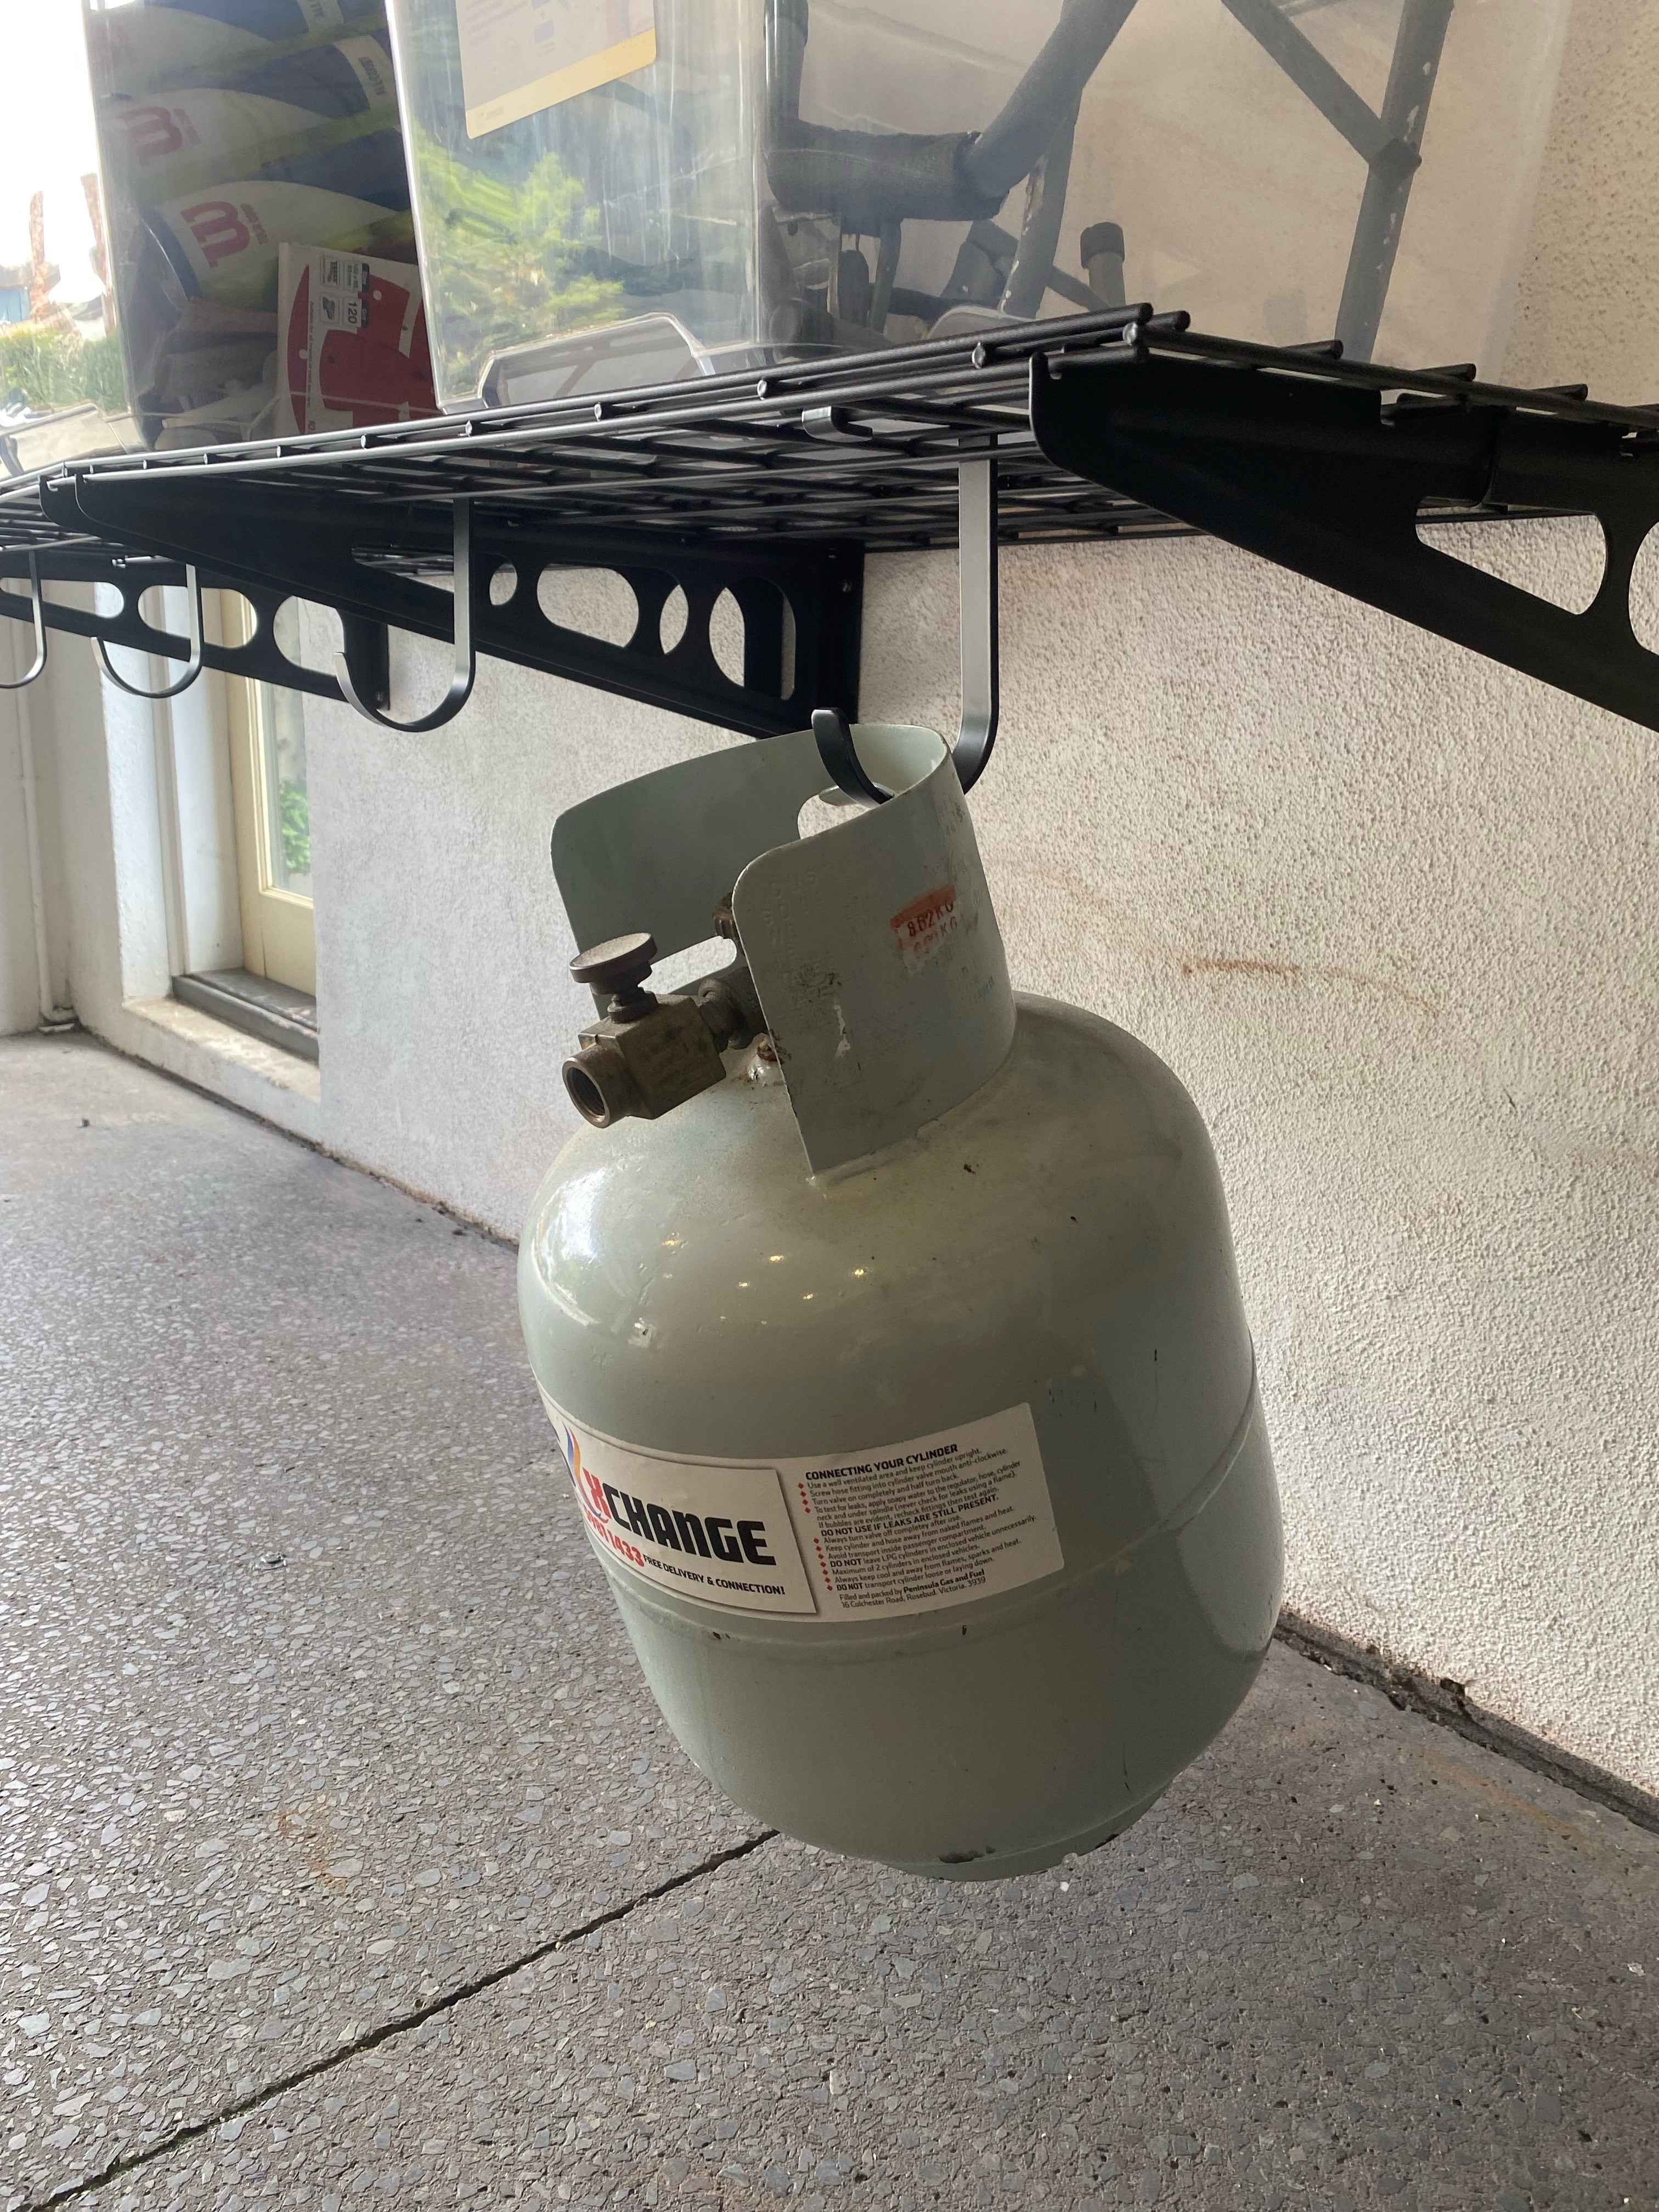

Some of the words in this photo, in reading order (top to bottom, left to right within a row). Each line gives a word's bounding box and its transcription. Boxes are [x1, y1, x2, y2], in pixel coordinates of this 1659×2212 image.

[348, 301, 358, 324] 120
[805, 1464, 872, 1480] CONNECTING
[873, 1458, 904, 1471] YOUR
[906, 1444, 957, 1464] CYLINDER
[828, 1479, 842, 1487] well
[843, 1474, 877, 1485] ventilated
[895, 1467, 908, 1476] and
[927, 1457, 952, 1469] cylinder
[887, 1476, 914, 1487] cylinder
[916, 1471, 933, 1480] valve
[934, 1464, 957, 1475] mouth
[848, 1510, 867, 1518] under
[868, 1505, 893, 1515] spindle
[918, 1495, 937, 1505] check
[949, 1488, 968, 1497] leaks
[968, 1482, 987, 1492] using
[857, 1488, 895, 1500] completely
[897, 1485, 910, 1493] and
[910, 1481, 924, 1490] half
[868, 1498, 885, 1508] apply
[887, 1496, 906, 1504] soapy
[907, 1491, 926, 1499] water
[996, 1461, 1020, 1474] cylinder
[825, 1520, 852, 1528] bubbles
[894, 1508, 919, 1519] recheck
[921, 1503, 946, 1512] fittings
[947, 1498, 963, 1506] then
[963, 1492, 977, 1501] test
[835, 1527, 853, 1535] NOT
[854, 1524, 872, 1533] USE
[883, 1517, 912, 1528] LEAKS
[913, 1513, 931, 1523] ARE
[932, 1507, 957, 1519] STILL
[843, 1542, 869, 1551] cylinder
[939, 1522, 960, 1533] naked
[961, 1517, 983, 1527] flames
[985, 1510, 997, 1520] and
[883, 1528, 892, 1537] off
[844, 1558, 861, 1566] NOT
[881, 1553, 897, 1561] LPG
[898, 1549, 928, 1559] cylinders
[937, 1537, 967, 1550] enclosed
[968, 1531, 990, 1542] vehicle
[848, 1549, 880, 1558] transport
[881, 1544, 901, 1554] inside
[903, 1538, 936, 1551] passenger
[876, 1569, 890, 1579] cool
[892, 1568, 905, 1577] and
[968, 1549, 990, 1560] sparks
[991, 1543, 1003, 1553] and
[882, 1561, 912, 1570] cylinders
[921, 1550, 950, 1562] enclosed
[643, 1554, 663, 1570] FREE
[664, 1563, 704, 1583] DELIVERY
[707, 1576, 715, 1586] &
[715, 1578, 786, 1595] CONNECTION!
[865, 1579, 896, 1588] transport
[898, 1574, 923, 1584] cylinder
[952, 1563, 973, 1572] laying
[871, 1589, 893, 1599] packed
[903, 1581, 939, 1593] Peninsula
[955, 1573, 968, 1582] and
[969, 1568, 985, 1578] Fuel
[850, 1596, 884, 1607] Colchester
[967, 1576, 986, 1587] 3939
